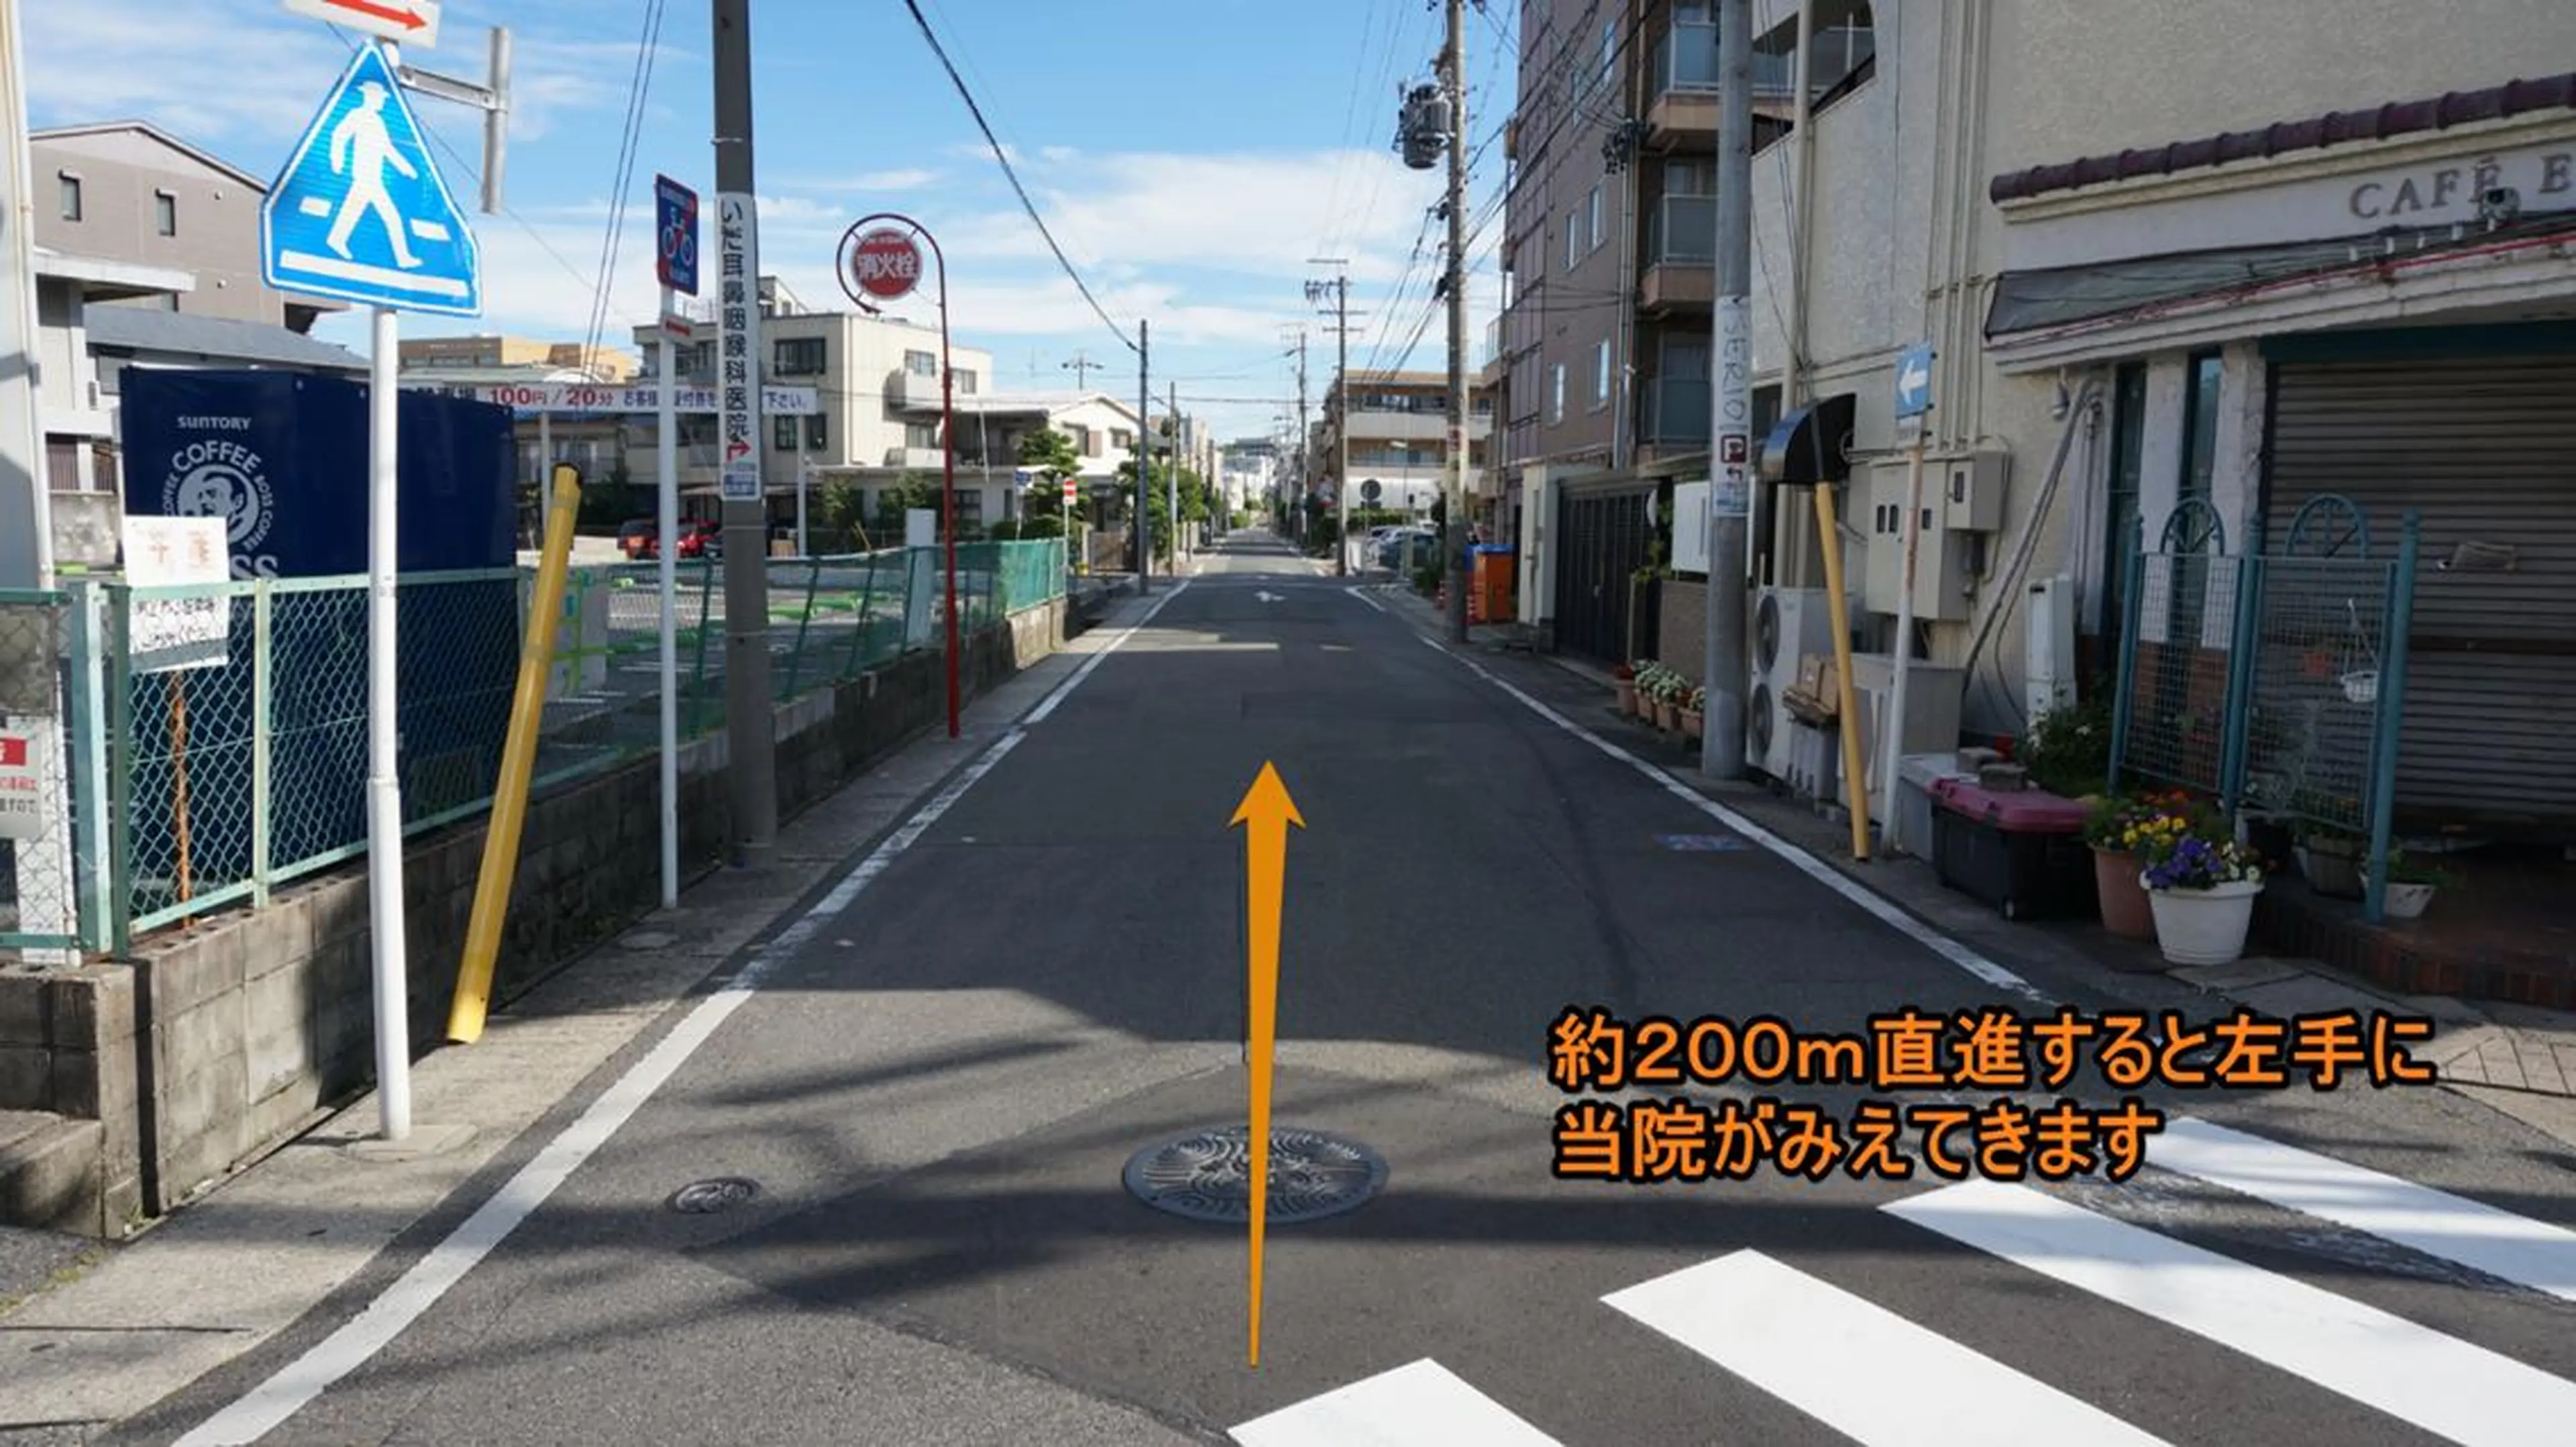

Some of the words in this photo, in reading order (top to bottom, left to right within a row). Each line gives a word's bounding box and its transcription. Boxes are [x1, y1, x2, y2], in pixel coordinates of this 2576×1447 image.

[858, 251, 916, 280] 消火栓
[172, 440, 262, 474] COFFEE
